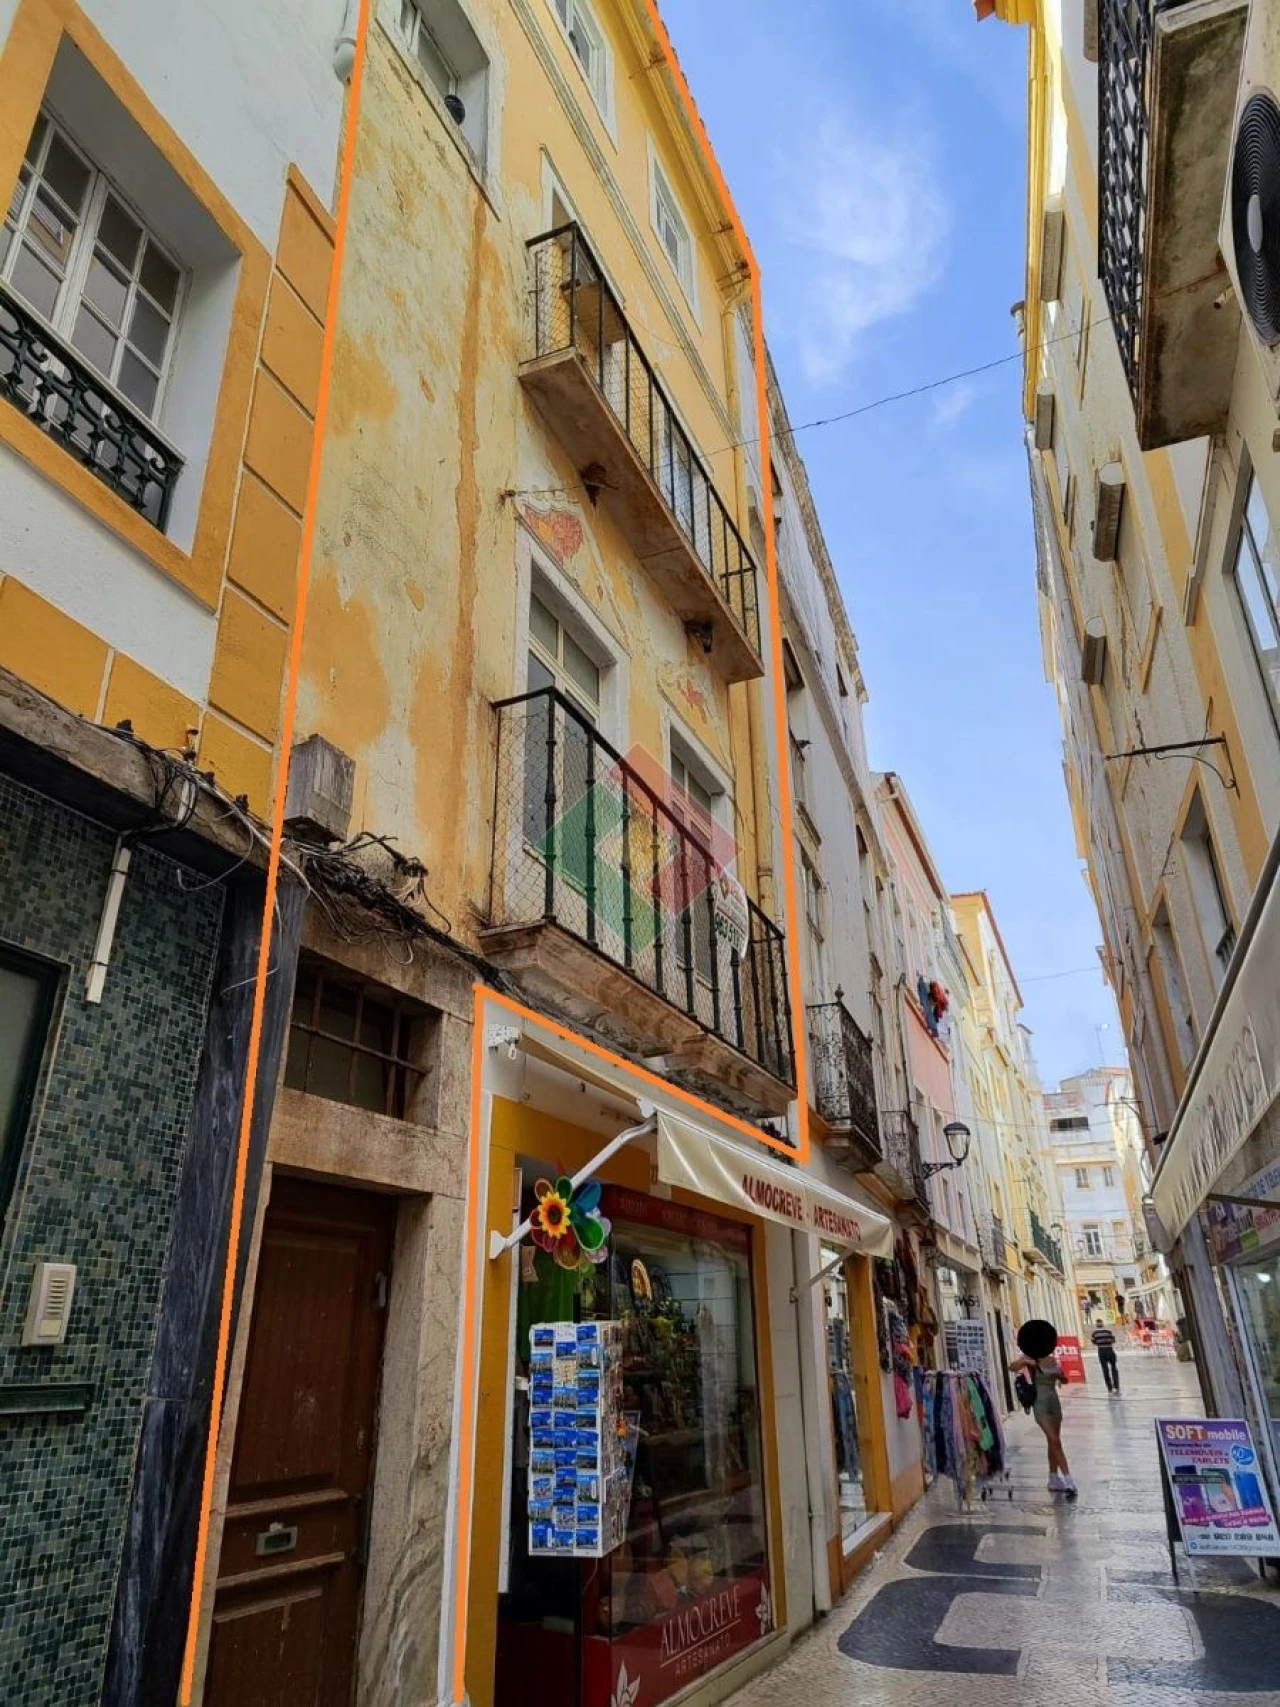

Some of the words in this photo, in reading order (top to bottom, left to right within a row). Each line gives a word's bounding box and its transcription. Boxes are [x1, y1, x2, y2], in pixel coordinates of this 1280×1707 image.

[742, 1174, 803, 1221] ALMOCREVE
[814, 1204, 862, 1241] ARTESANATO
[1165, 1424, 1204, 1440] SOFT
[1207, 1429, 1247, 1441] mobile
[661, 1585, 741, 1662] ALMOCREVE
[676, 1632, 731, 1678] ARTESANATO
